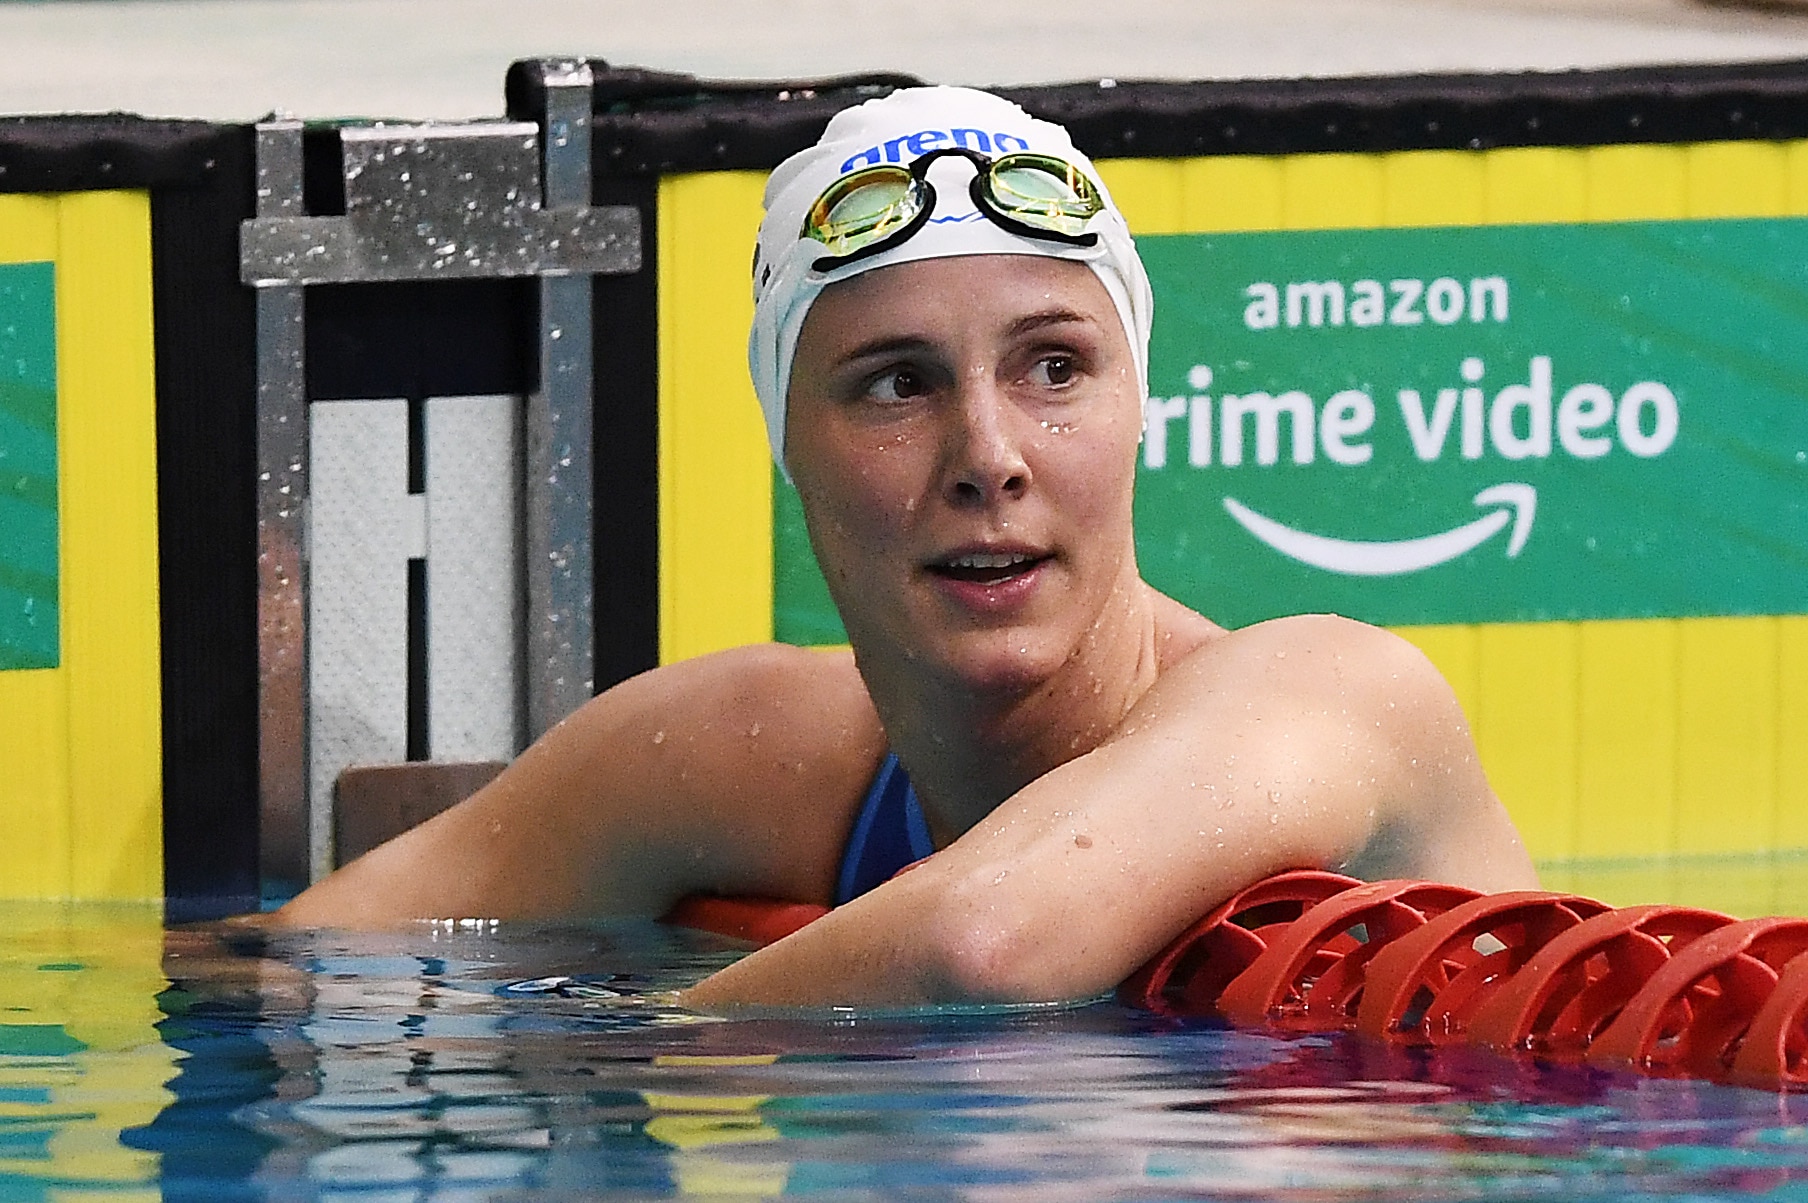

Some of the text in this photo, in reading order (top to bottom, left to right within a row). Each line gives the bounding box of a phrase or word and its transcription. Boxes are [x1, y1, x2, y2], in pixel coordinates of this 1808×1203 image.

[1244, 276, 1509, 330] amazon
[1143, 355, 1680, 469] rime video
